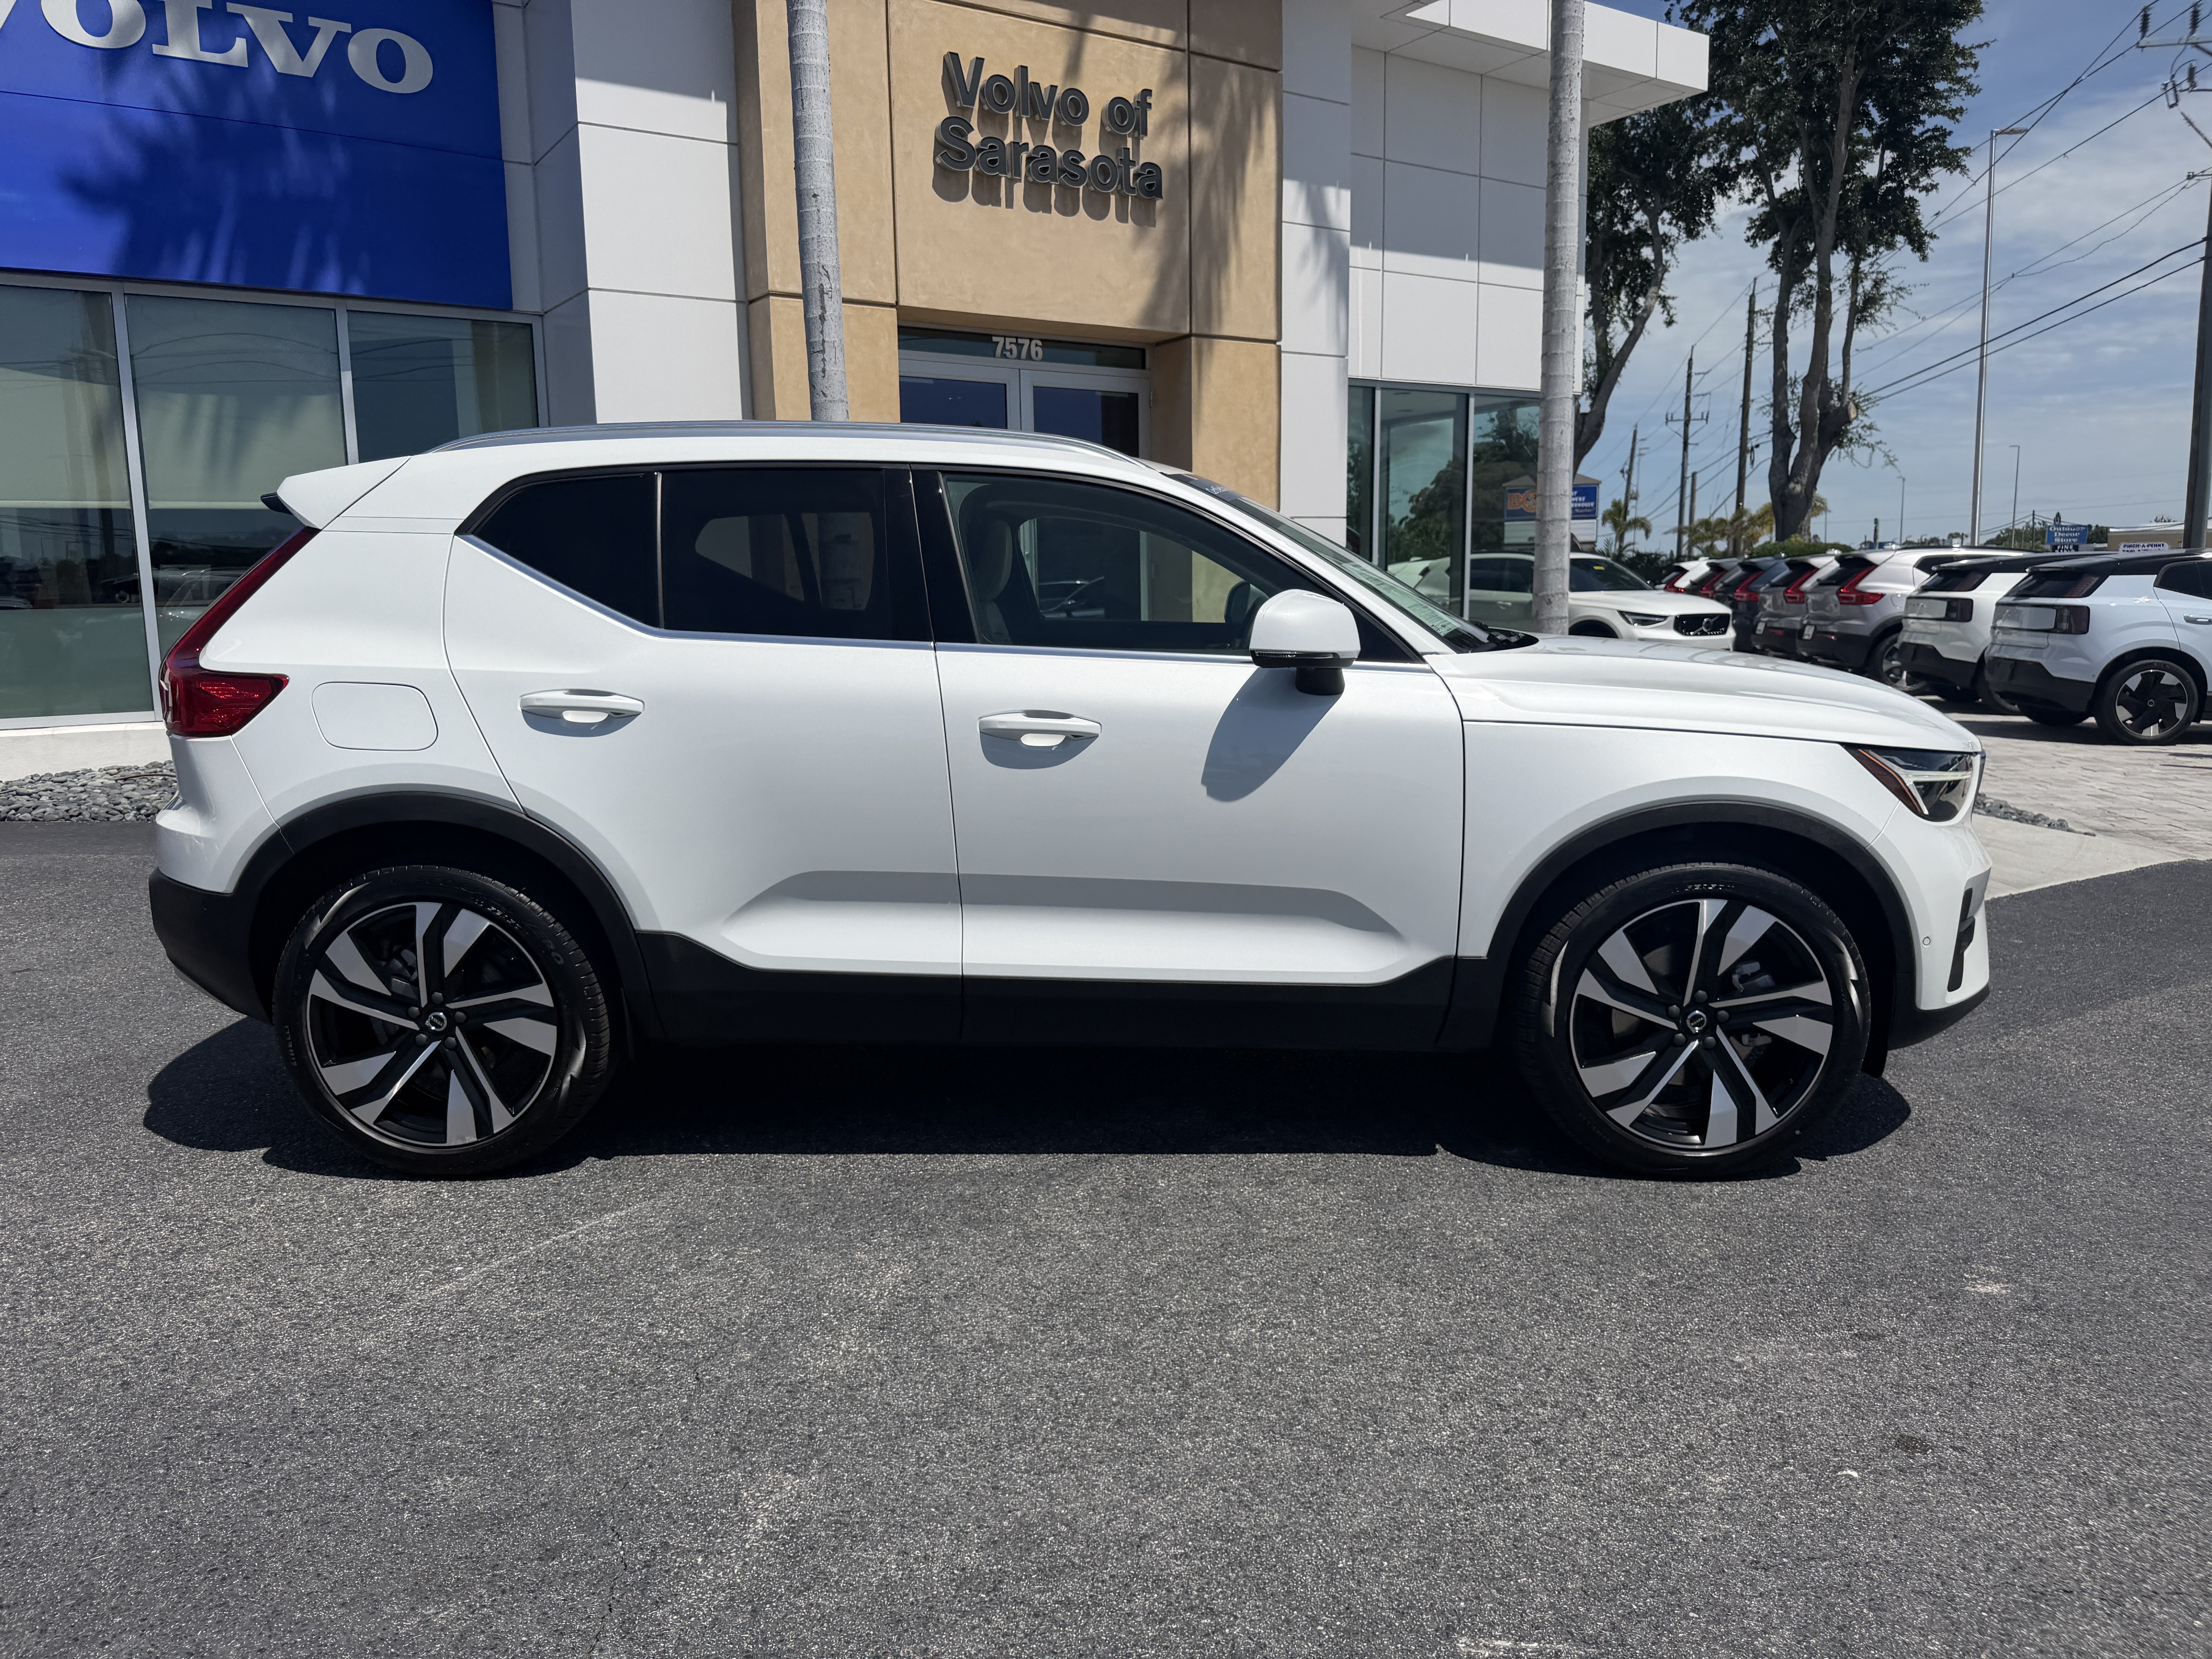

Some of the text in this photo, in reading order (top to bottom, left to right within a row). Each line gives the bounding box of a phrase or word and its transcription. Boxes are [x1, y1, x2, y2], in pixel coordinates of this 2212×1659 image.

[0, 0, 434, 94] OLVO
[943, 51, 1153, 138] Volvo of
[934, 116, 1163, 201] Sarasota
[992, 336, 1043, 361] 7576
